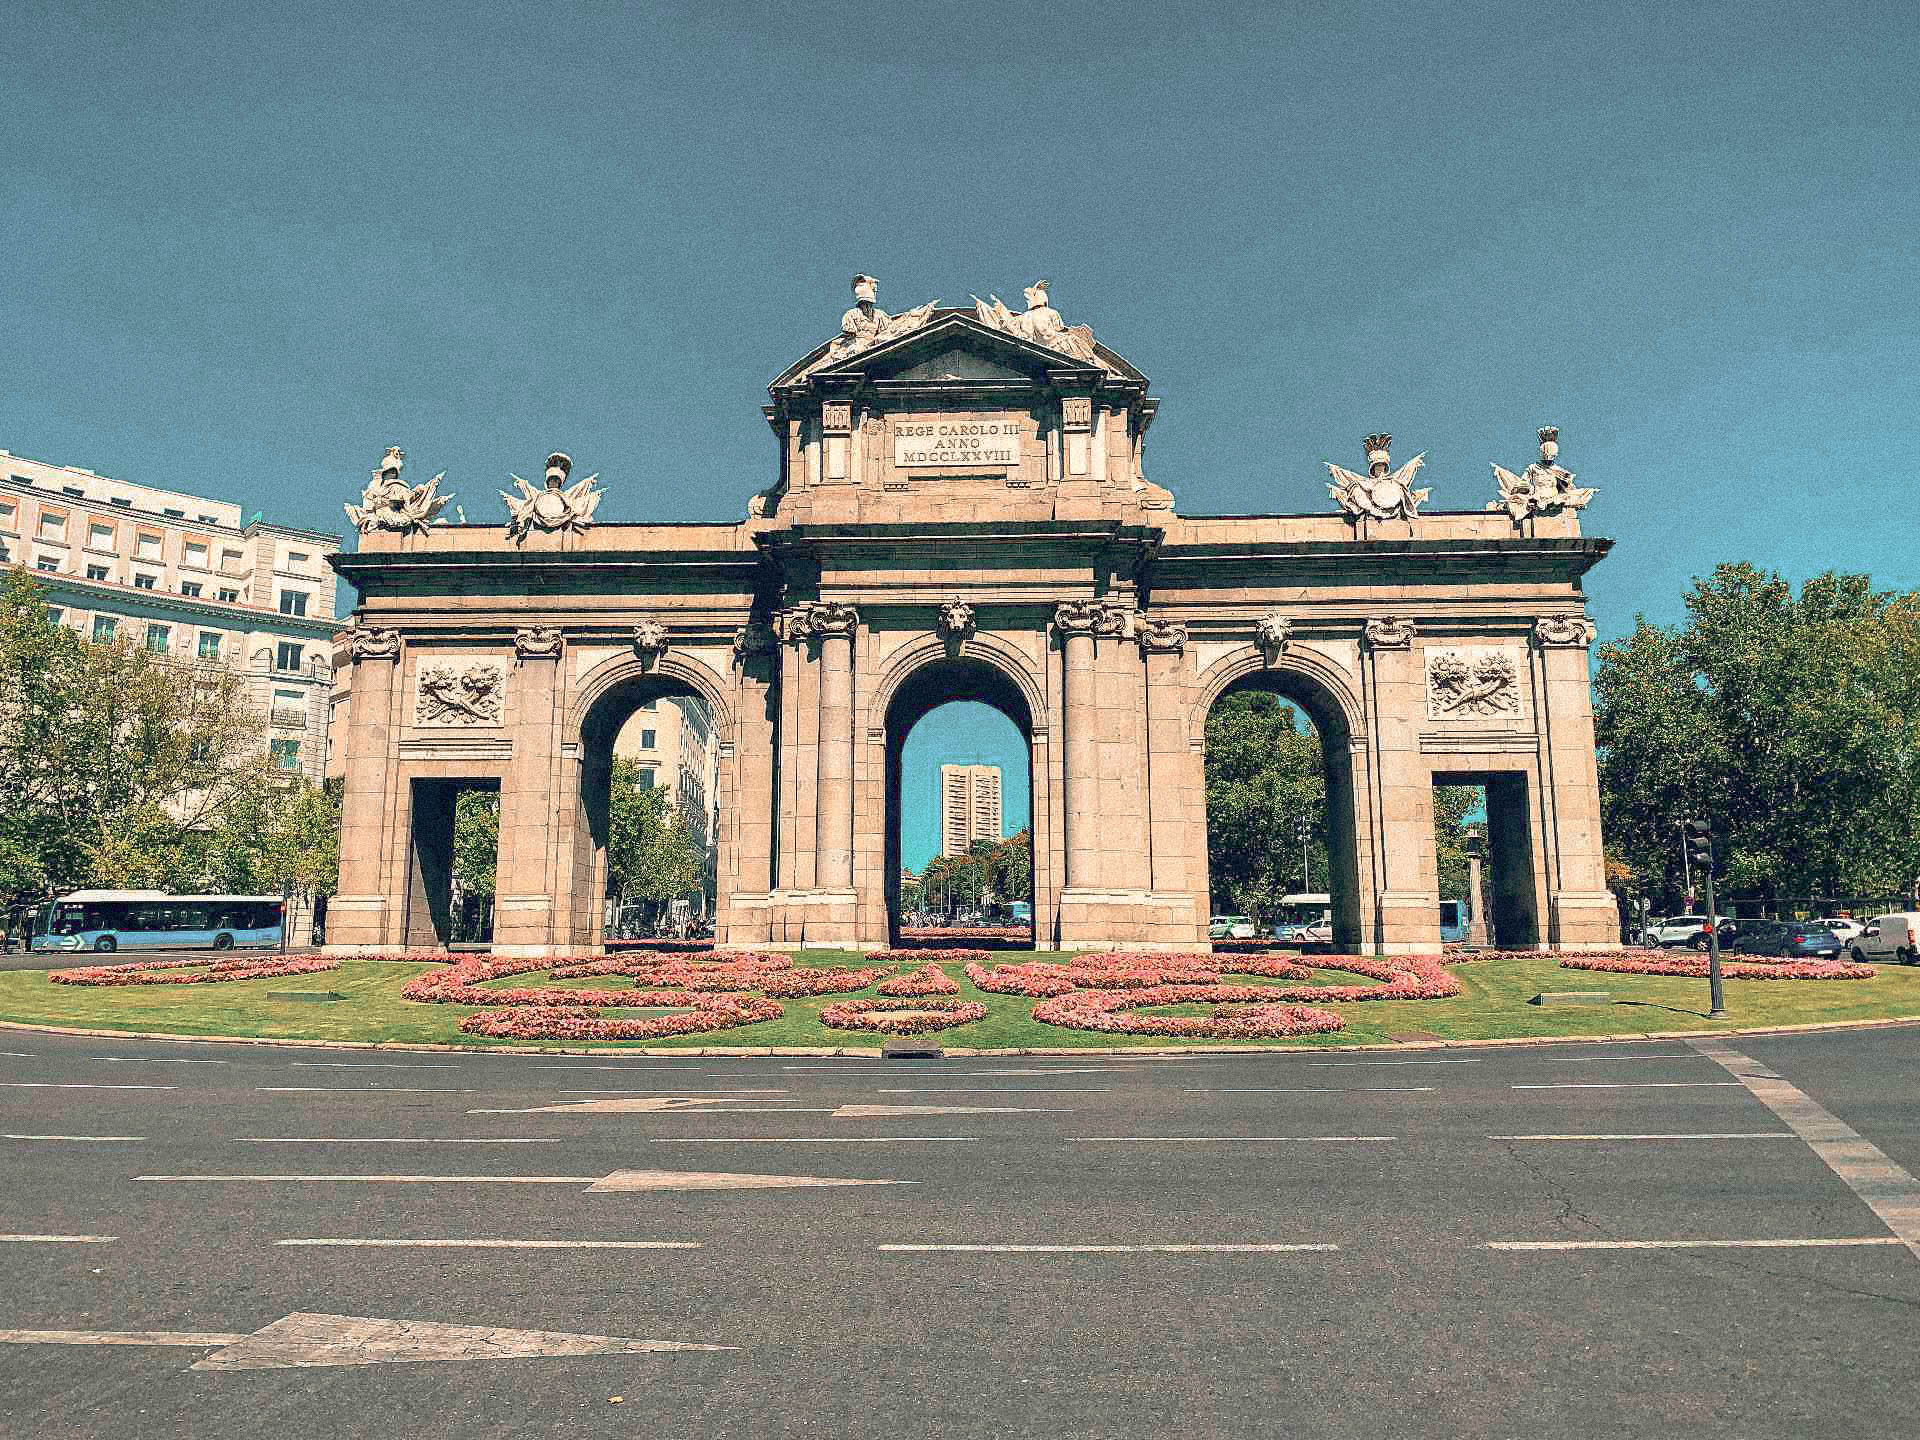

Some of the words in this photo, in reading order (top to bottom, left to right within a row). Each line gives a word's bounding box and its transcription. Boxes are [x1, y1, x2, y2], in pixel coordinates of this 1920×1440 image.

[895, 426, 934, 437] REGE
[938, 425, 999, 436] CAROLO
[1003, 424, 1020, 435] III
[935, 438, 980, 449] ANNO
[903, 450, 1011, 462] MDCCLXXVIII
